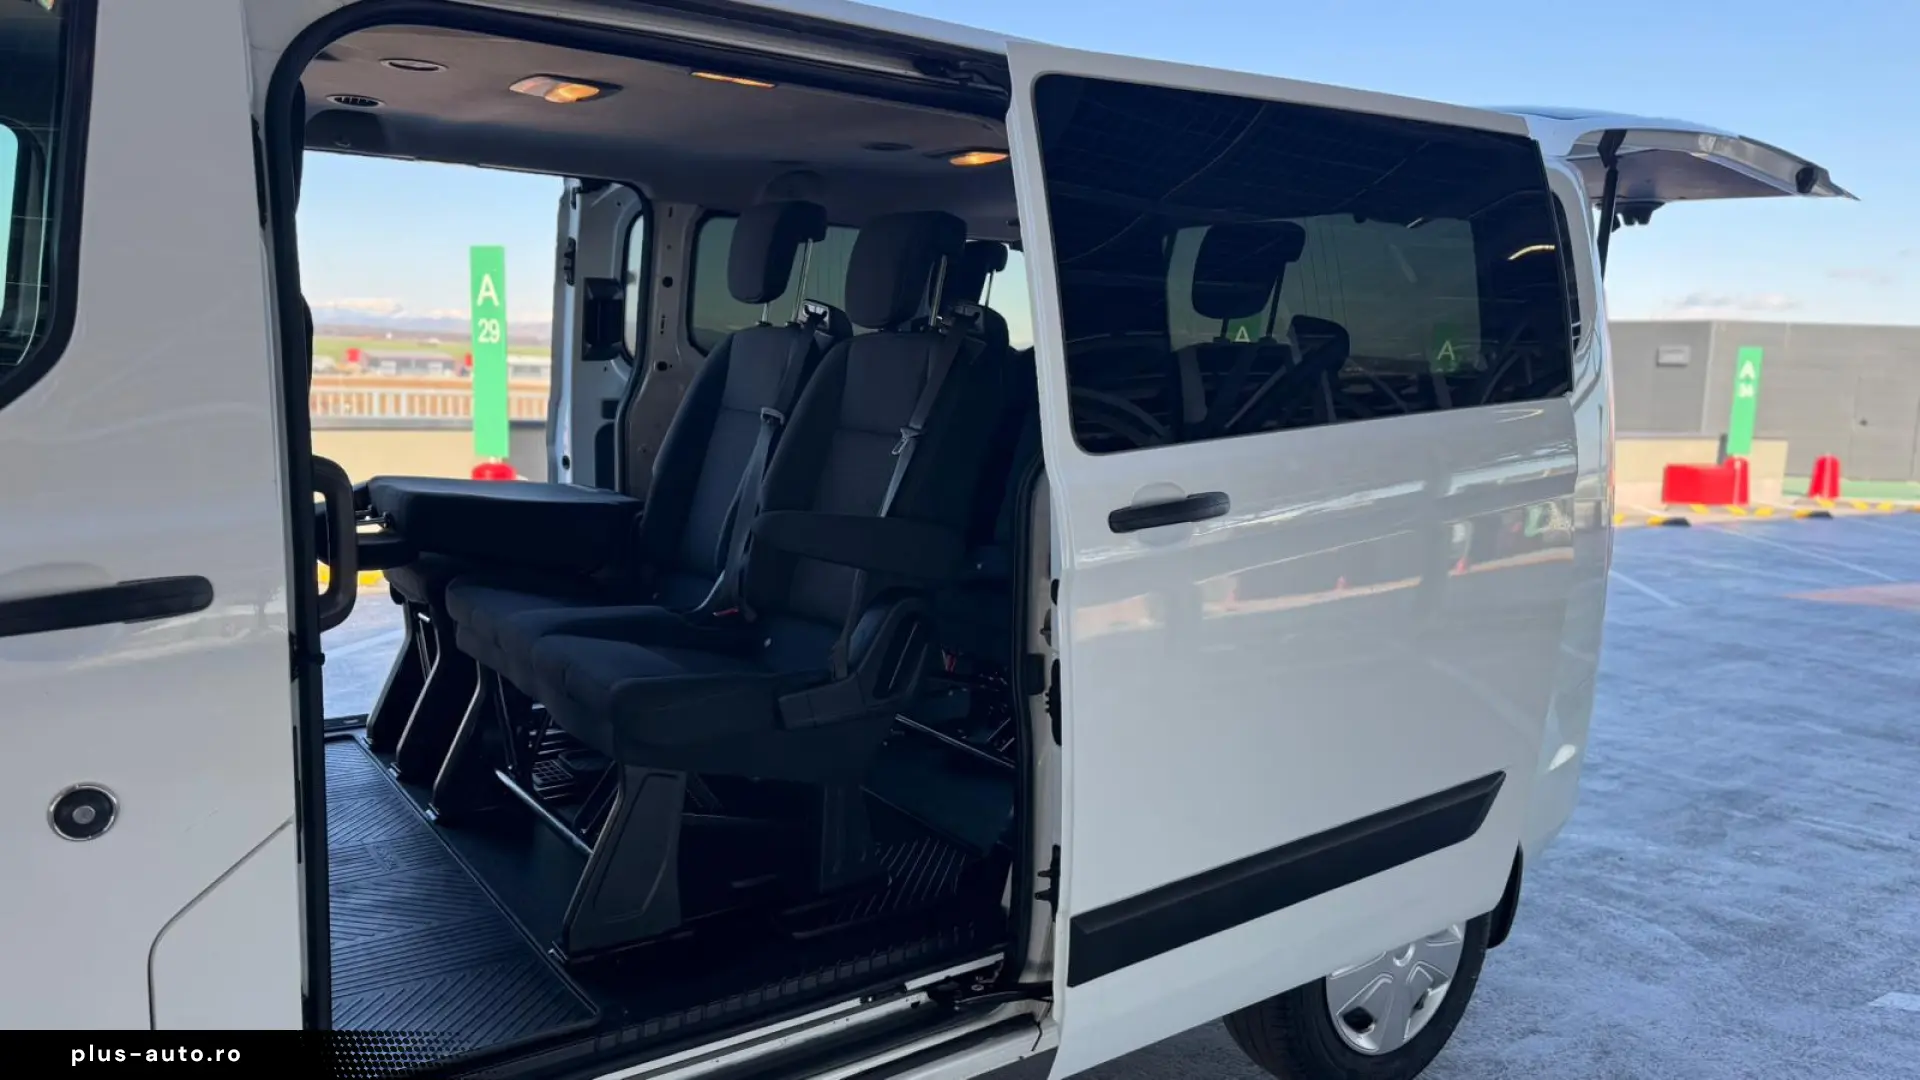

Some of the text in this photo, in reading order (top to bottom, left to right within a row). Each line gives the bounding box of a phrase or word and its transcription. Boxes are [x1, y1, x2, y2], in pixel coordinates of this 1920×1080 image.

[476, 273, 500, 307] A
[477, 318, 501, 344] 29
[1436, 340, 1455, 361] A
[1739, 360, 1756, 379] A
